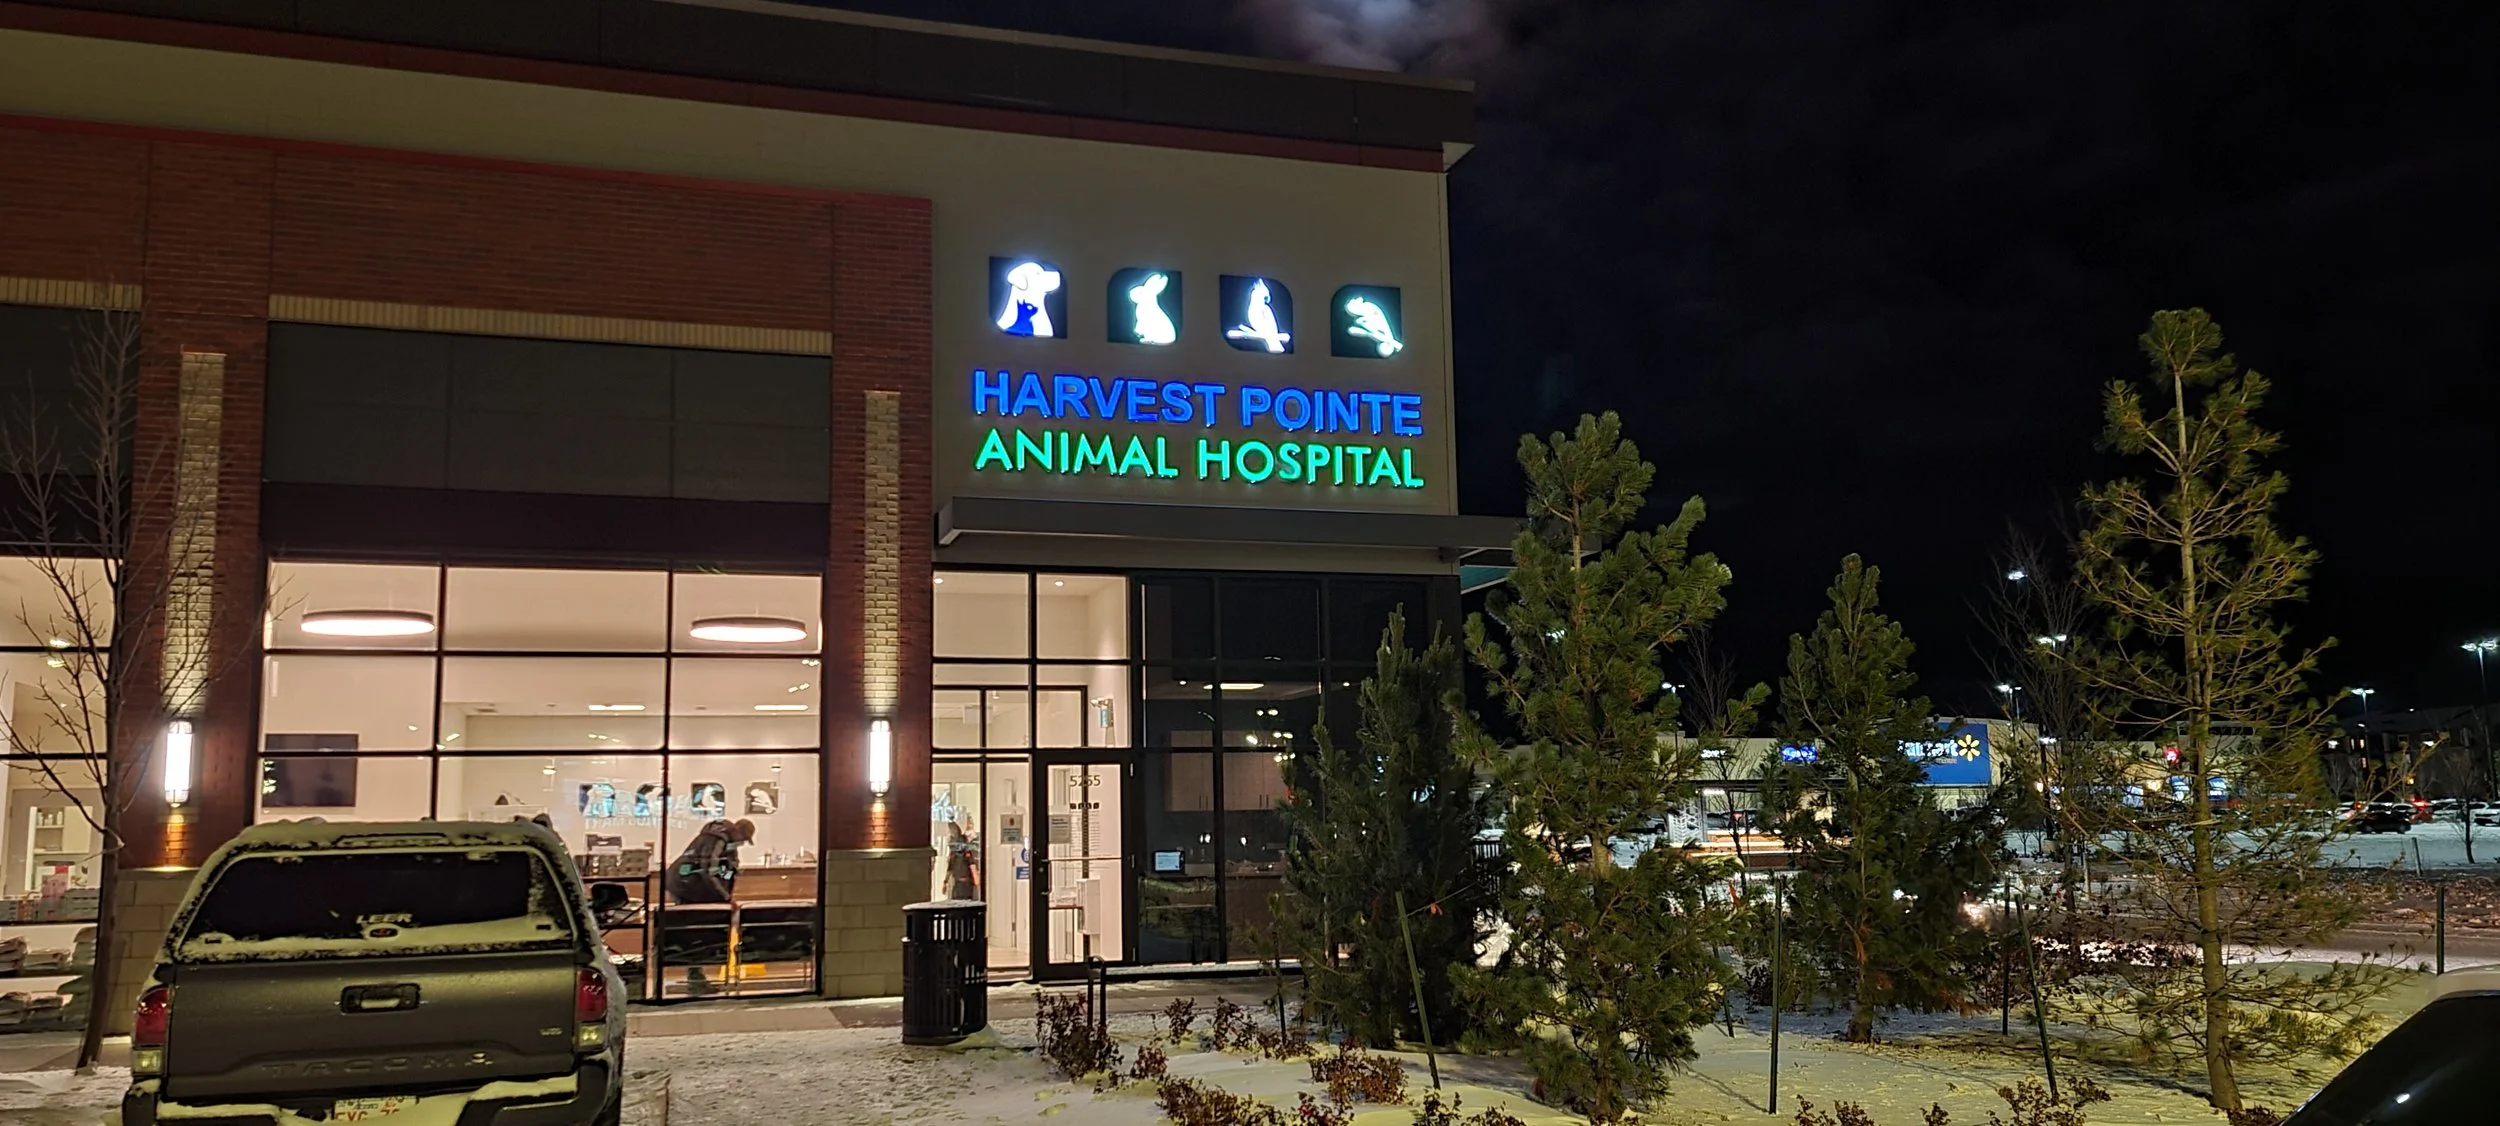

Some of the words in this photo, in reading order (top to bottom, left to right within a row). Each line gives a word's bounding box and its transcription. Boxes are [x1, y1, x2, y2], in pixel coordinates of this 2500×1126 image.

[973, 369, 1226, 428] HARVEST
[1240, 384, 1424, 437] POINTE
[974, 427, 1179, 479] ANIMAL
[1197, 438, 1425, 488] HOSPITAL
[356, 913, 413, 924] LEER
[261, 1051, 494, 1079] TACOMA
